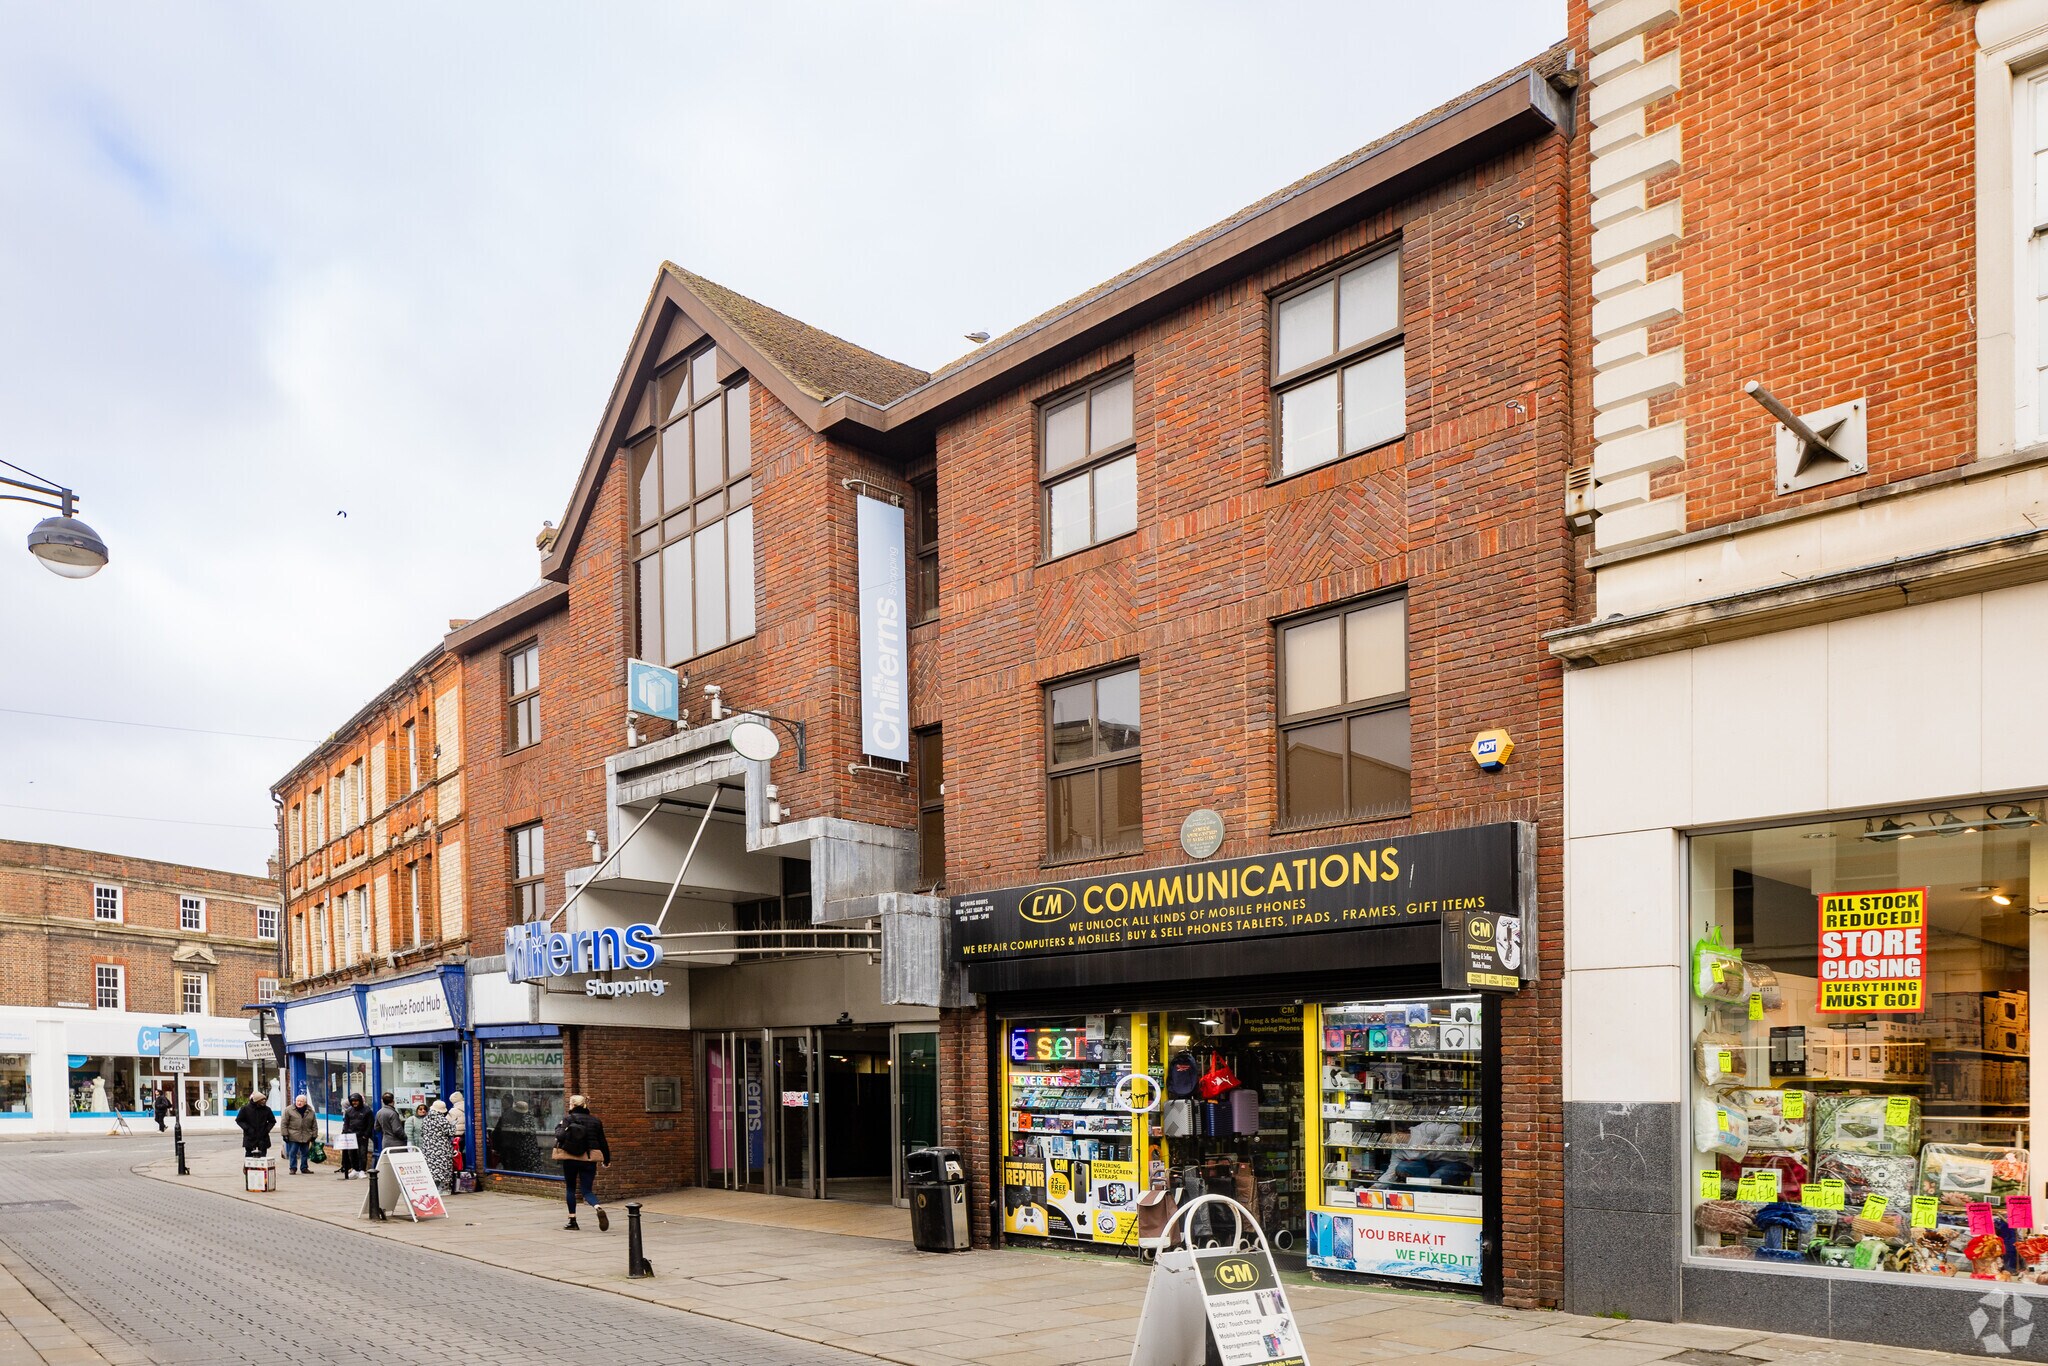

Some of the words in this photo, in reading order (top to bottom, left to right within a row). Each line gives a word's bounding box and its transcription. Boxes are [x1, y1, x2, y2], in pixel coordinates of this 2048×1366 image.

[872, 597, 901, 750] Chilterns
[888, 546, 898, 596] Shopping
[1478, 740, 1496, 752] ADT
[1032, 894, 1062, 916] CM
[1083, 847, 1400, 914] COMMUNICATIONS
[1826, 899, 1854, 912] ALL
[1860, 894, 1919, 911] STOCK
[1070, 922, 1083, 932] WE
[1086, 918, 1128, 930] UNLOCK
[1132, 916, 1150, 926] ALL
[1154, 912, 1186, 924] KINDS
[1190, 910, 1205, 920] OF
[1209, 905, 1252, 918] MOBILE
[1256, 899, 1306, 913] PHONES
[1826, 910, 1919, 927] REDUCED!
[963, 945, 975, 954] WE
[978, 943, 1008, 953] REPAIR
[1010, 937, 1065, 950] COMPUTERS
[1068, 937, 1074, 945] &
[1128, 930, 1147, 940] BUY
[1150, 929, 1157, 938] &
[1161, 926, 1183, 937] SELL
[1188, 922, 1232, 934] PHONES
[1237, 916, 1288, 930] TABLETS,
[1292, 912, 1330, 925] IPADS
[1343, 905, 1401, 920] FRAMES,
[1406, 901, 1437, 914] GIFT
[1443, 896, 1485, 911] ITEMS
[1471, 921, 1490, 938] CM
[1822, 928, 1922, 958] STORE
[505, 921, 664, 984] Chilterns
[1822, 958, 1920, 979] CLOSING
[586, 976, 664, 997] Shopping
[1826, 982, 1917, 992] EVERYTHING
[380, 1000, 408, 1020] Wycombe
[409, 996, 424, 1014] Food
[427, 994, 440, 1011] Hub
[1826, 994, 1879, 1007] MUST
[1884, 994, 1916, 1006] GO!
[1055, 1159, 1068, 1171] CM
[1006, 1169, 1044, 1188] REPAIR
[1701, 1182, 1720, 1198] £15
[1759, 1184, 1775, 1200] £10
[1824, 1191, 1843, 1205] £10
[1862, 1203, 1882, 1220] £10
[1914, 1209, 1934, 1225] £10
[1358, 1228, 1384, 1240] YOU
[1388, 1231, 1430, 1244] BREAK
[1434, 1235, 1446, 1246] IT
[1396, 1249, 1415, 1260] WE
[1419, 1251, 1457, 1265] FIXED
[1462, 1255, 1473, 1267] IT
[1219, 1264, 1253, 1284] CM
[1226, 1299, 1249, 1307] Repairing
[1236, 1329, 1261, 1338] Unlocking
[1222, 1340, 1261, 1350] Reprogramming
[1226, 1352, 1252, 1360] Formatting
